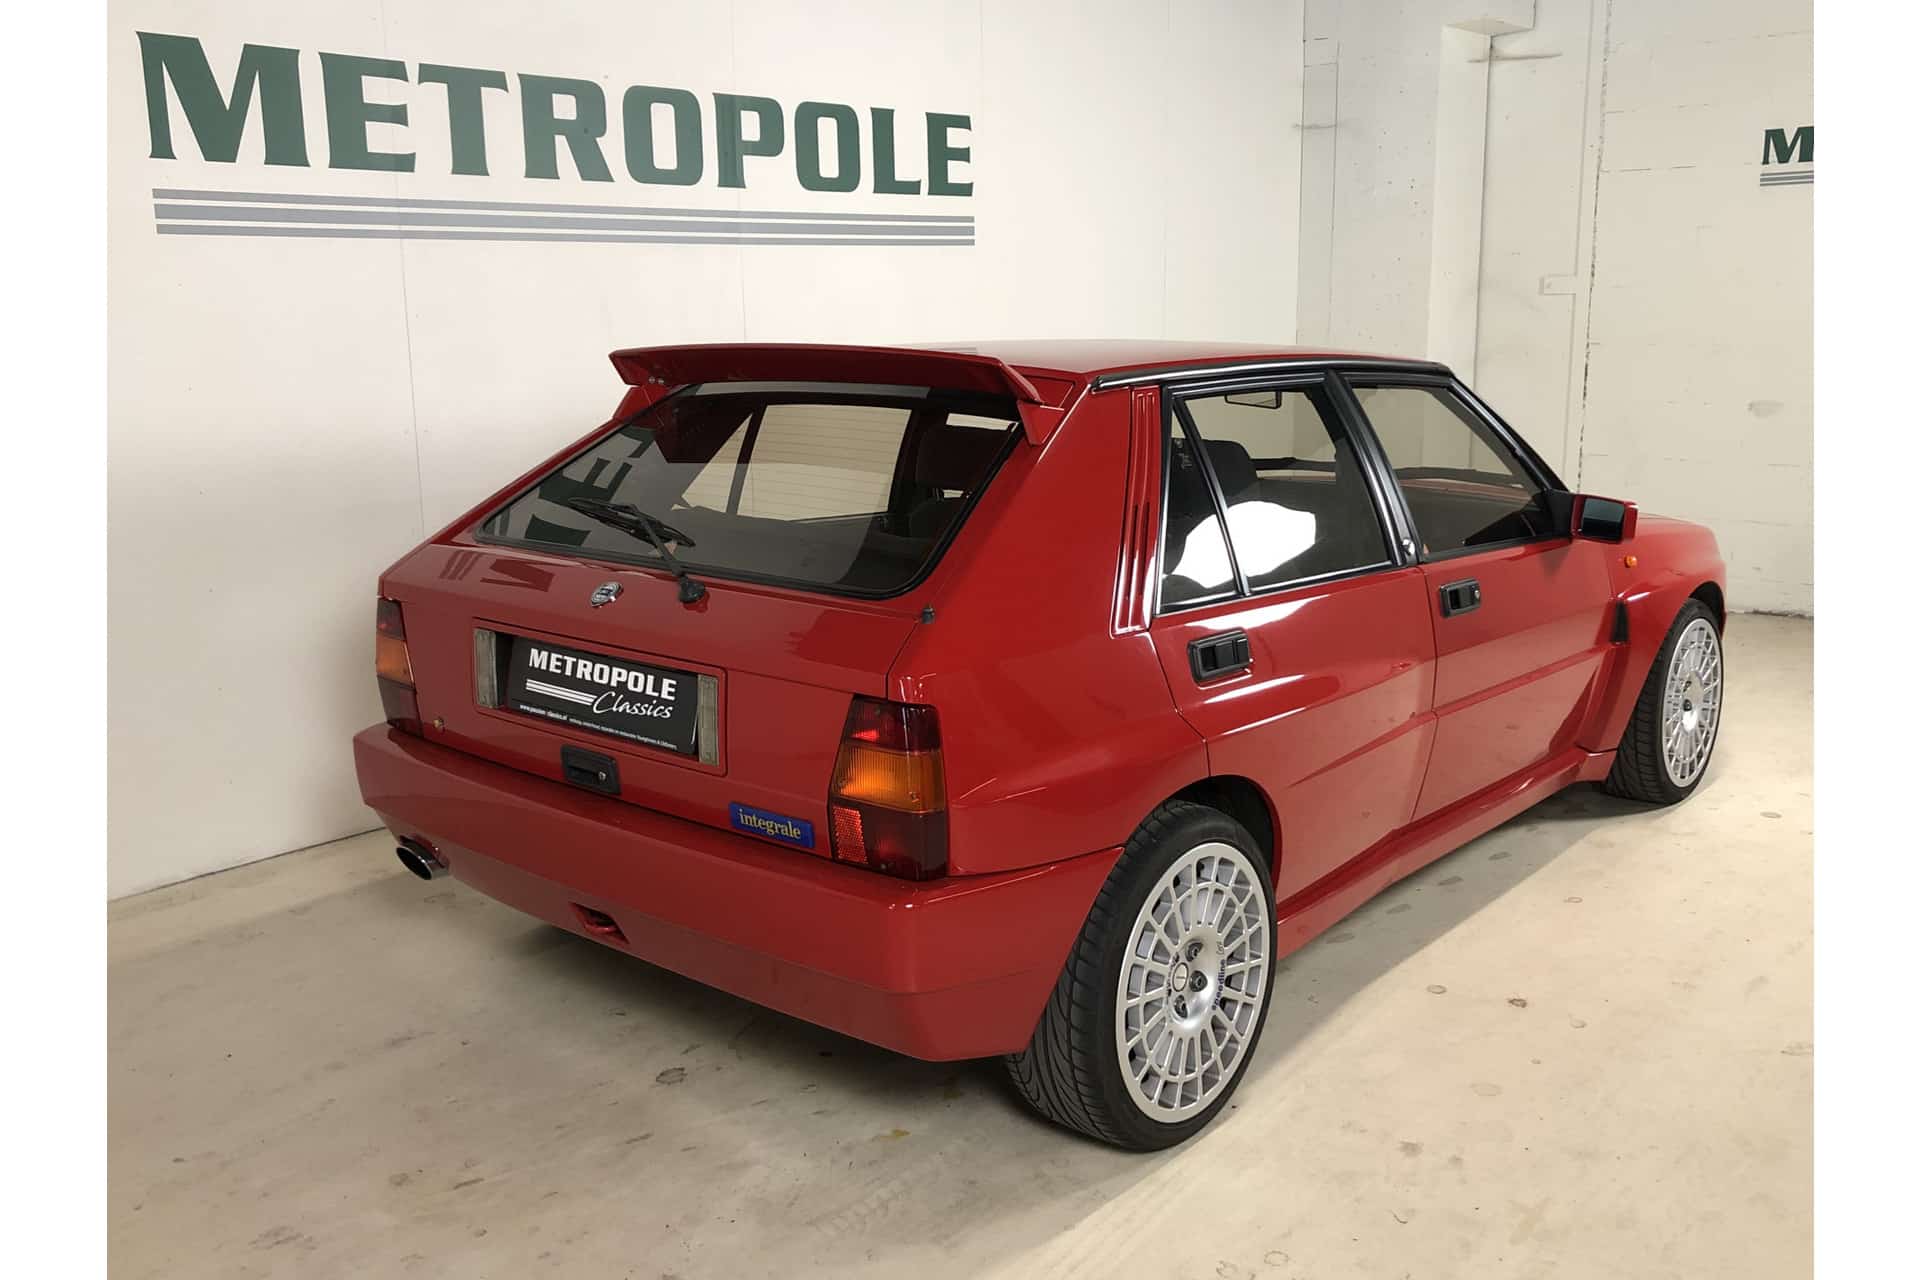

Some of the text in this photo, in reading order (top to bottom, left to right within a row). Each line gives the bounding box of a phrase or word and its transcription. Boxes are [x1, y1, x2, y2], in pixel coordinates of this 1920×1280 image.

[136, 31, 974, 197] METROPOLE
[529, 647, 677, 701] METROPOLE
[592, 691, 673, 719] Classics
[738, 808, 801, 840] integrale
